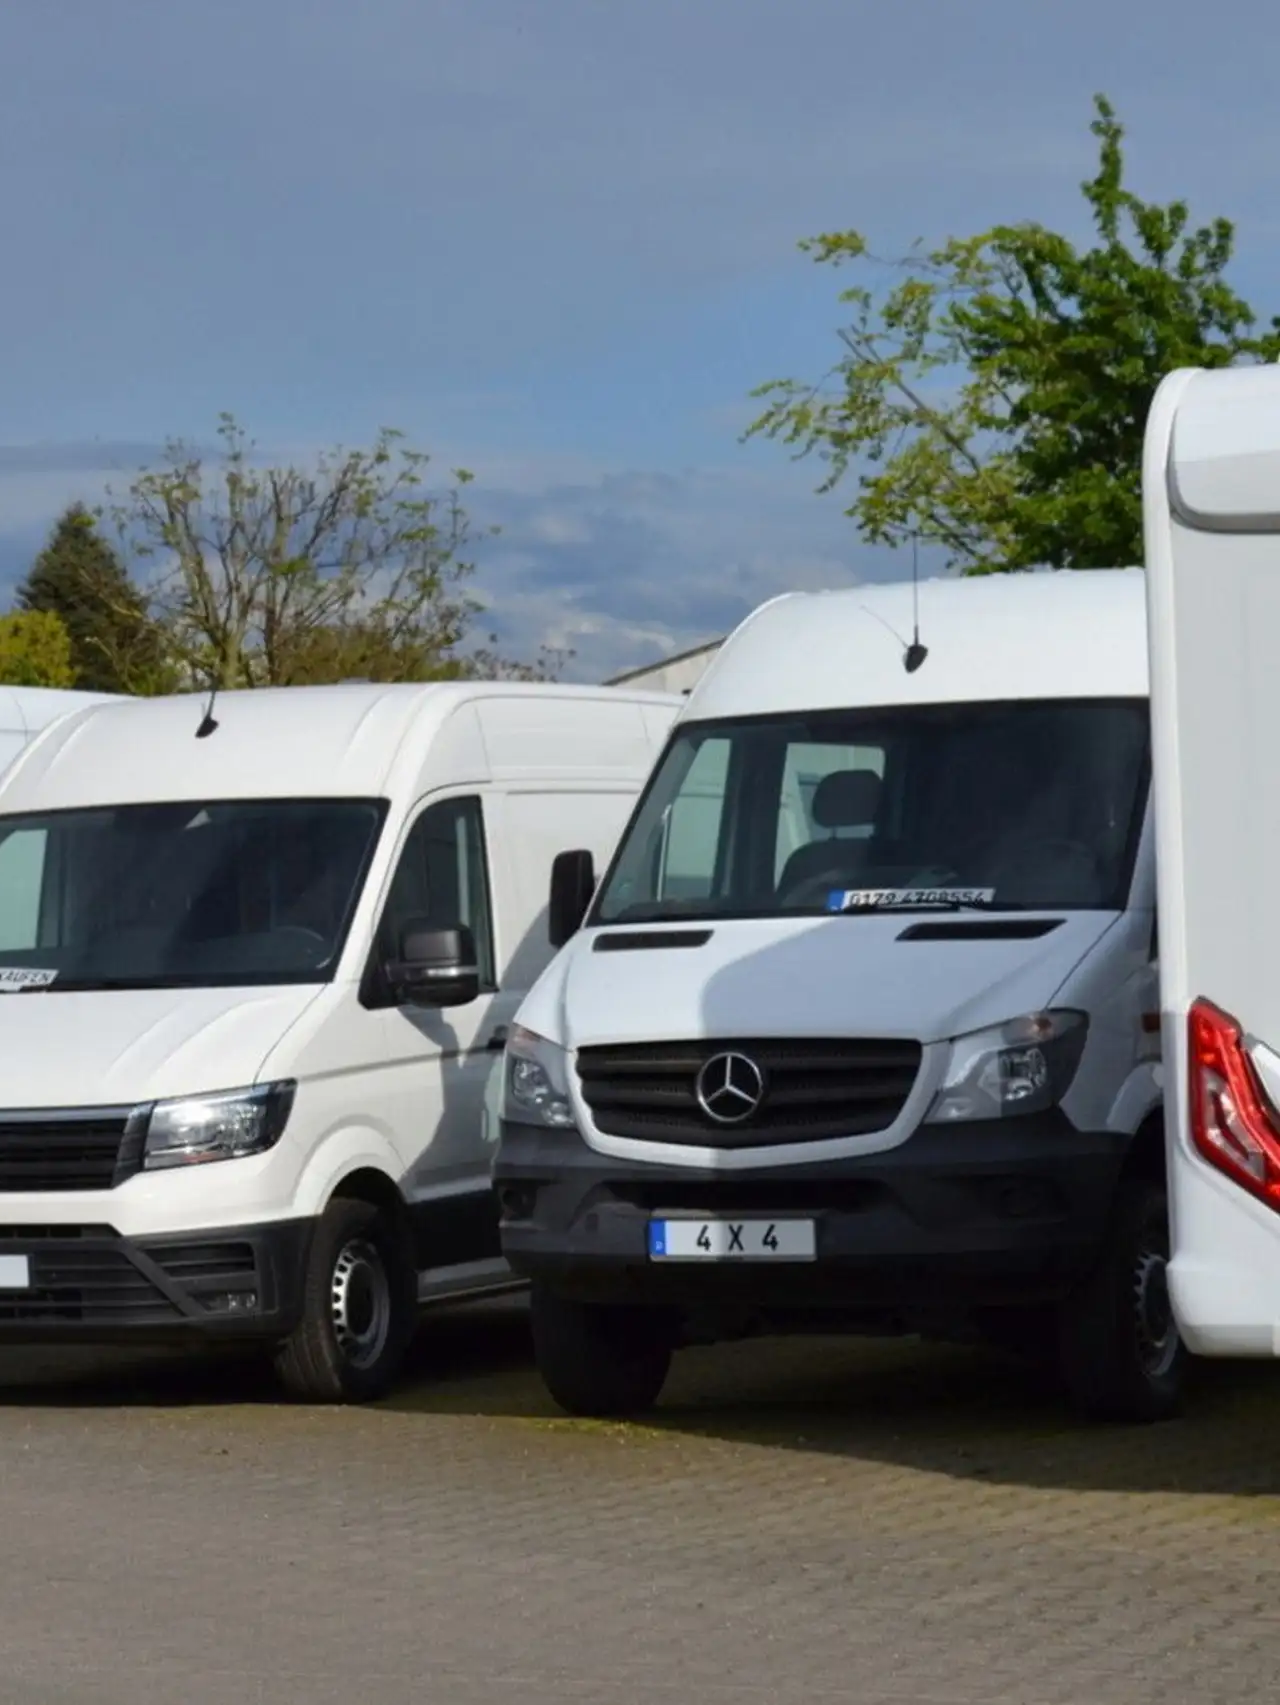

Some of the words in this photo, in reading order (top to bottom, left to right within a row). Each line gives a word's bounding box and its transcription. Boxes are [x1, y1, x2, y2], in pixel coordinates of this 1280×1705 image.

[696, 1223, 712, 1252] 4
[727, 1223, 745, 1252] X
[761, 1223, 779, 1252] 4
